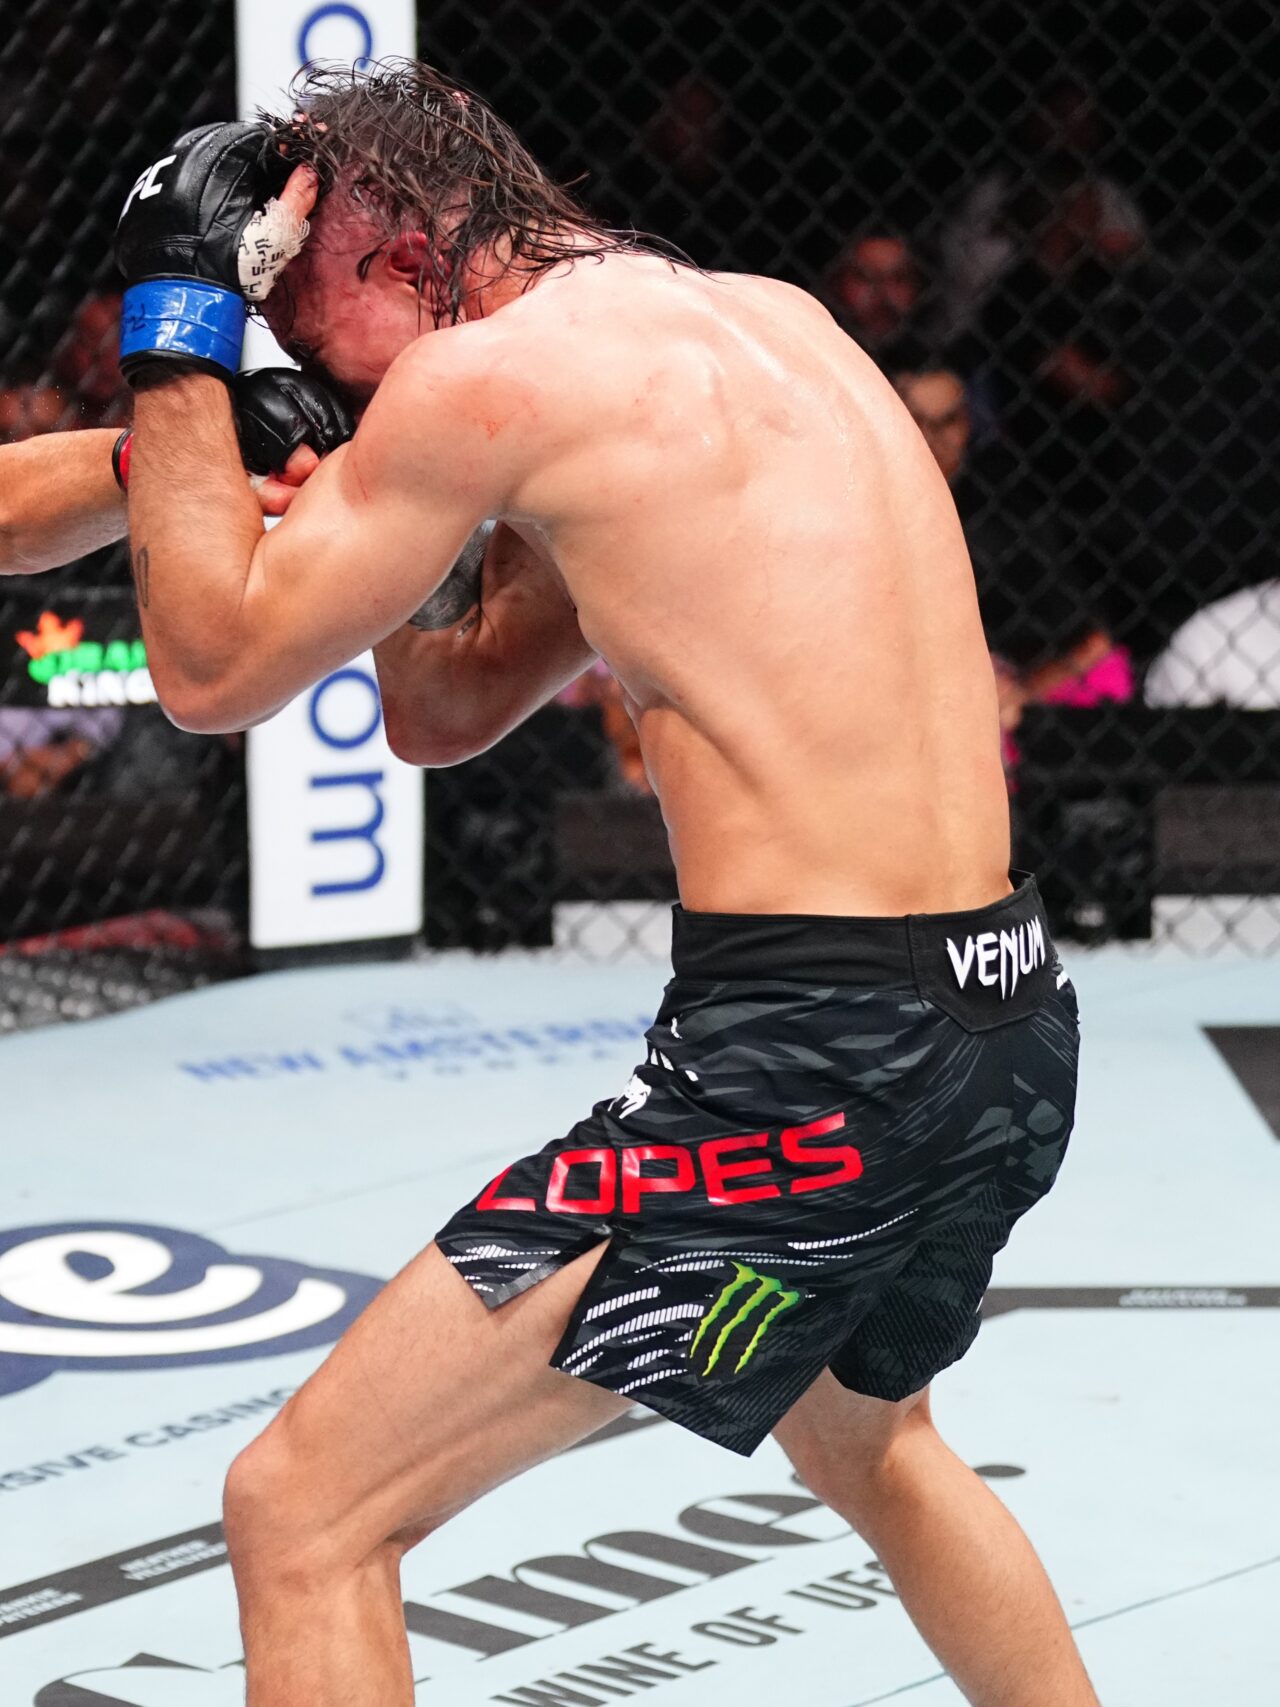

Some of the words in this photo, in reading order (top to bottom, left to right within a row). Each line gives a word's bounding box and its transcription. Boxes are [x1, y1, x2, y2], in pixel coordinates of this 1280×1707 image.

[118, 154, 177, 218] FC
[946, 915, 1046, 1000] VENUM
[475, 1111, 863, 1214] LOPES
[490, 1642, 719, 1707] WINE
[690, 1605, 806, 1648] OF
[783, 1560, 898, 1611] UF
